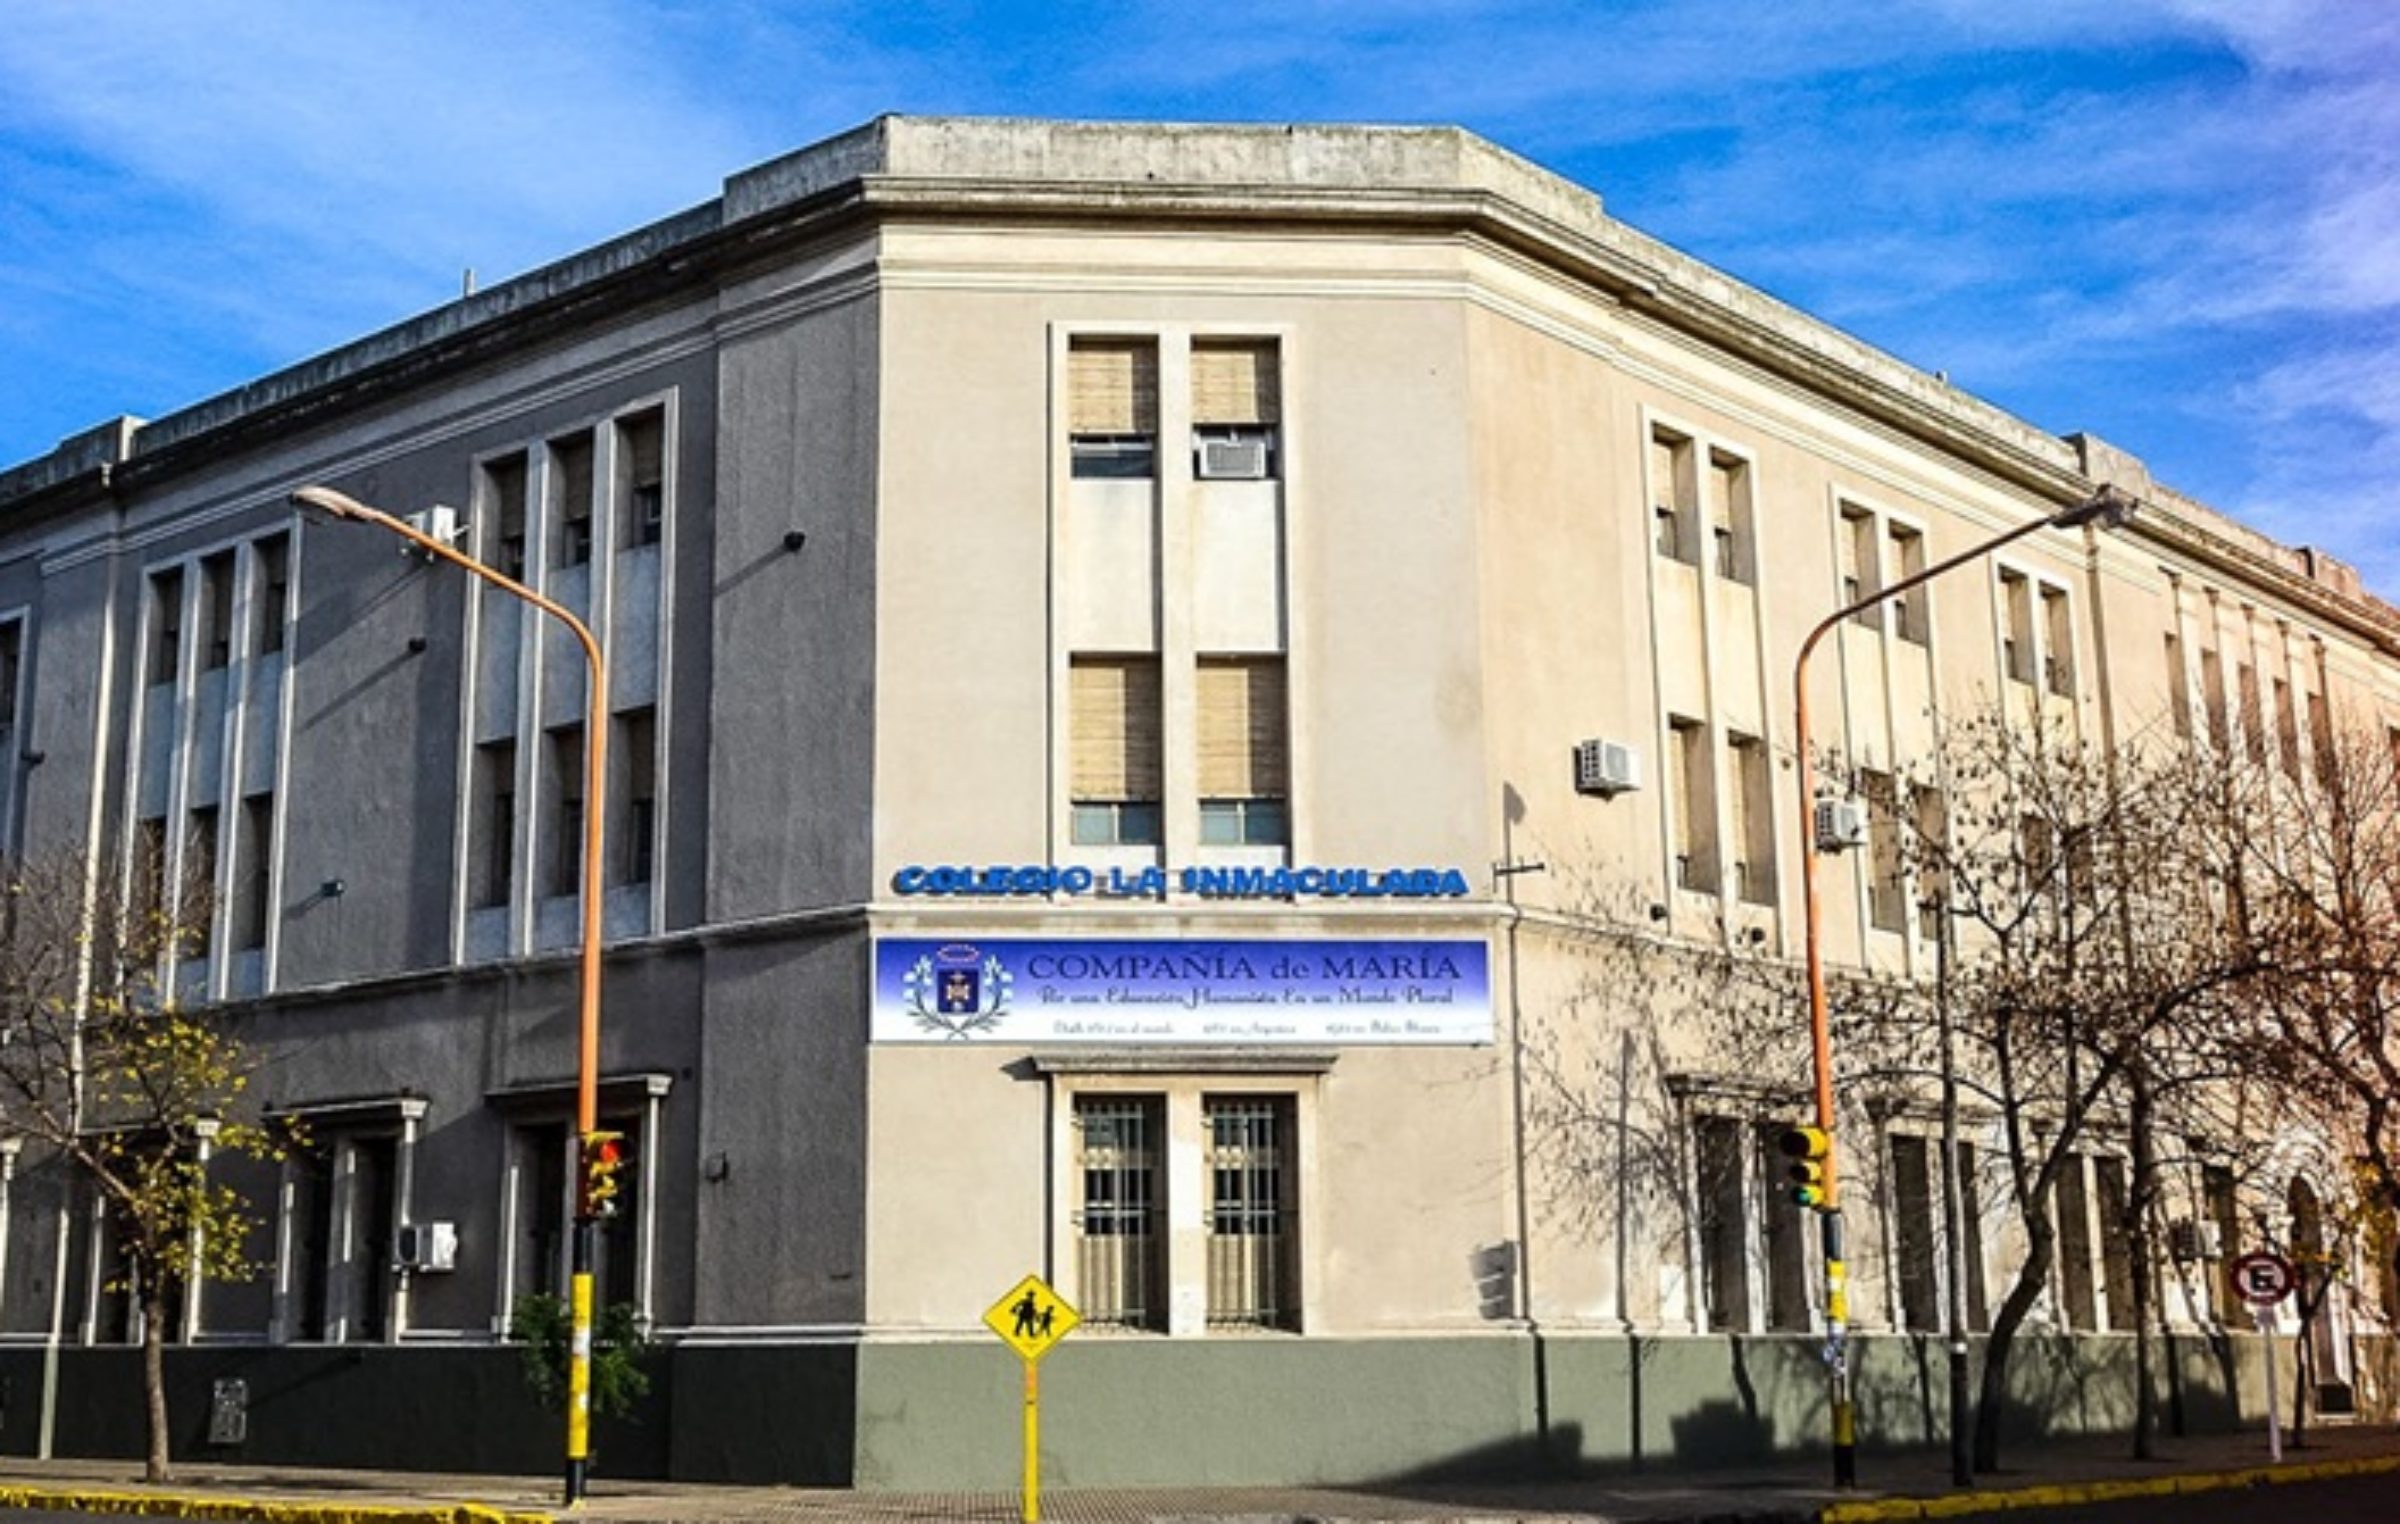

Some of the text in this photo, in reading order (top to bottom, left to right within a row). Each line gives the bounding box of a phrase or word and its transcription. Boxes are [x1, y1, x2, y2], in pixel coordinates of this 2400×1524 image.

[894, 866, 1469, 895] COLEGIO LA INMACULADA
[1027, 948, 1462, 980] COMPAÑÍA de MARÍA
